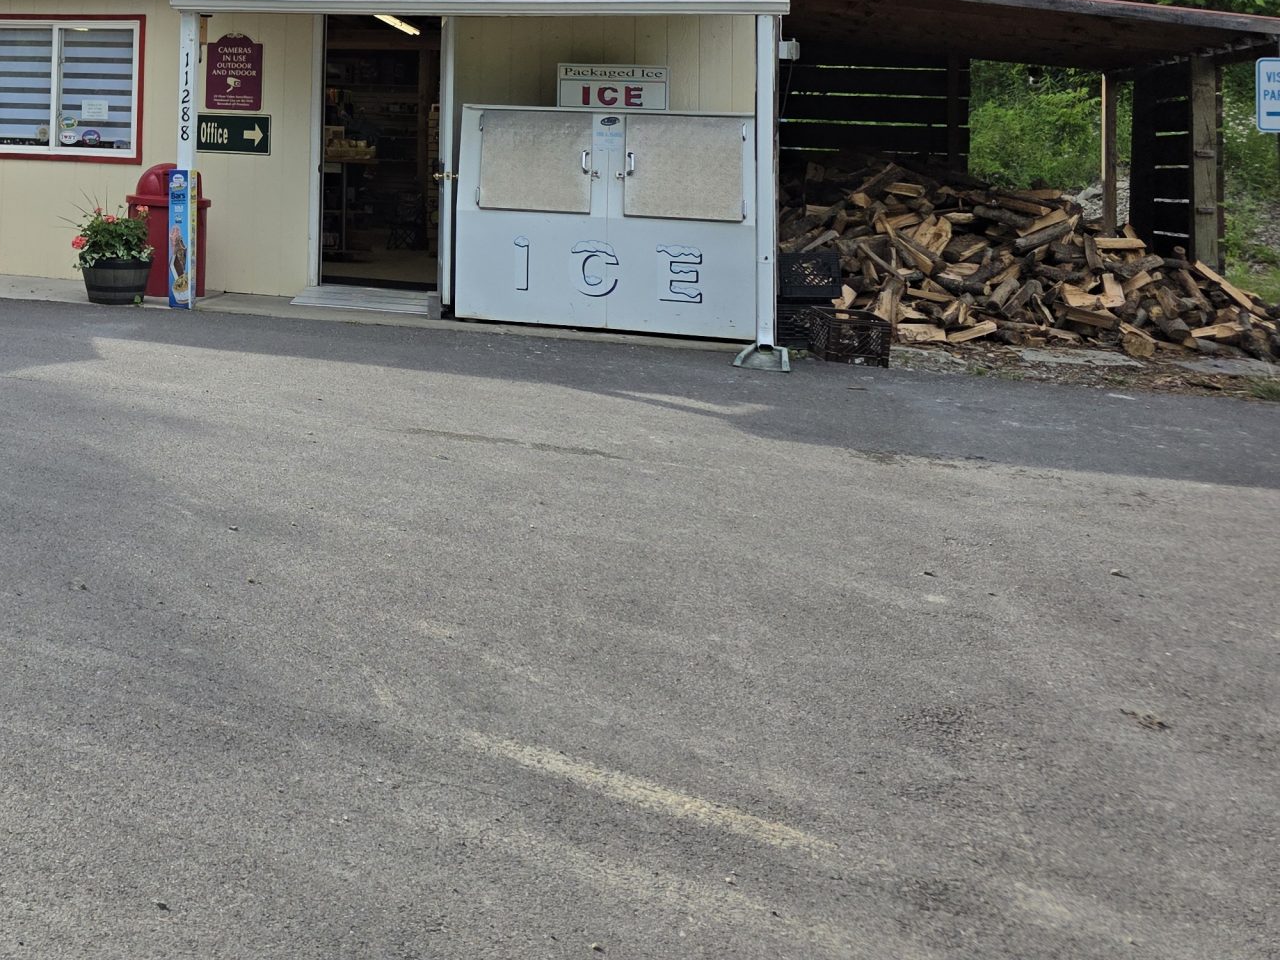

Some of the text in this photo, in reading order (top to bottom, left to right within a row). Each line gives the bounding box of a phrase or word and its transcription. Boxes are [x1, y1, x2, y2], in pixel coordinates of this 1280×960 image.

[218, 46, 252, 54] CAMERAS
[222, 54, 231, 62] IN
[228, 69, 257, 77] INDOOR
[564, 67, 663, 78] Packaged Ice
[181, 52, 191, 141] 11288
[581, 85, 643, 107] ICE
[200, 122, 229, 144] Office
[514, 236, 703, 304] ICE
